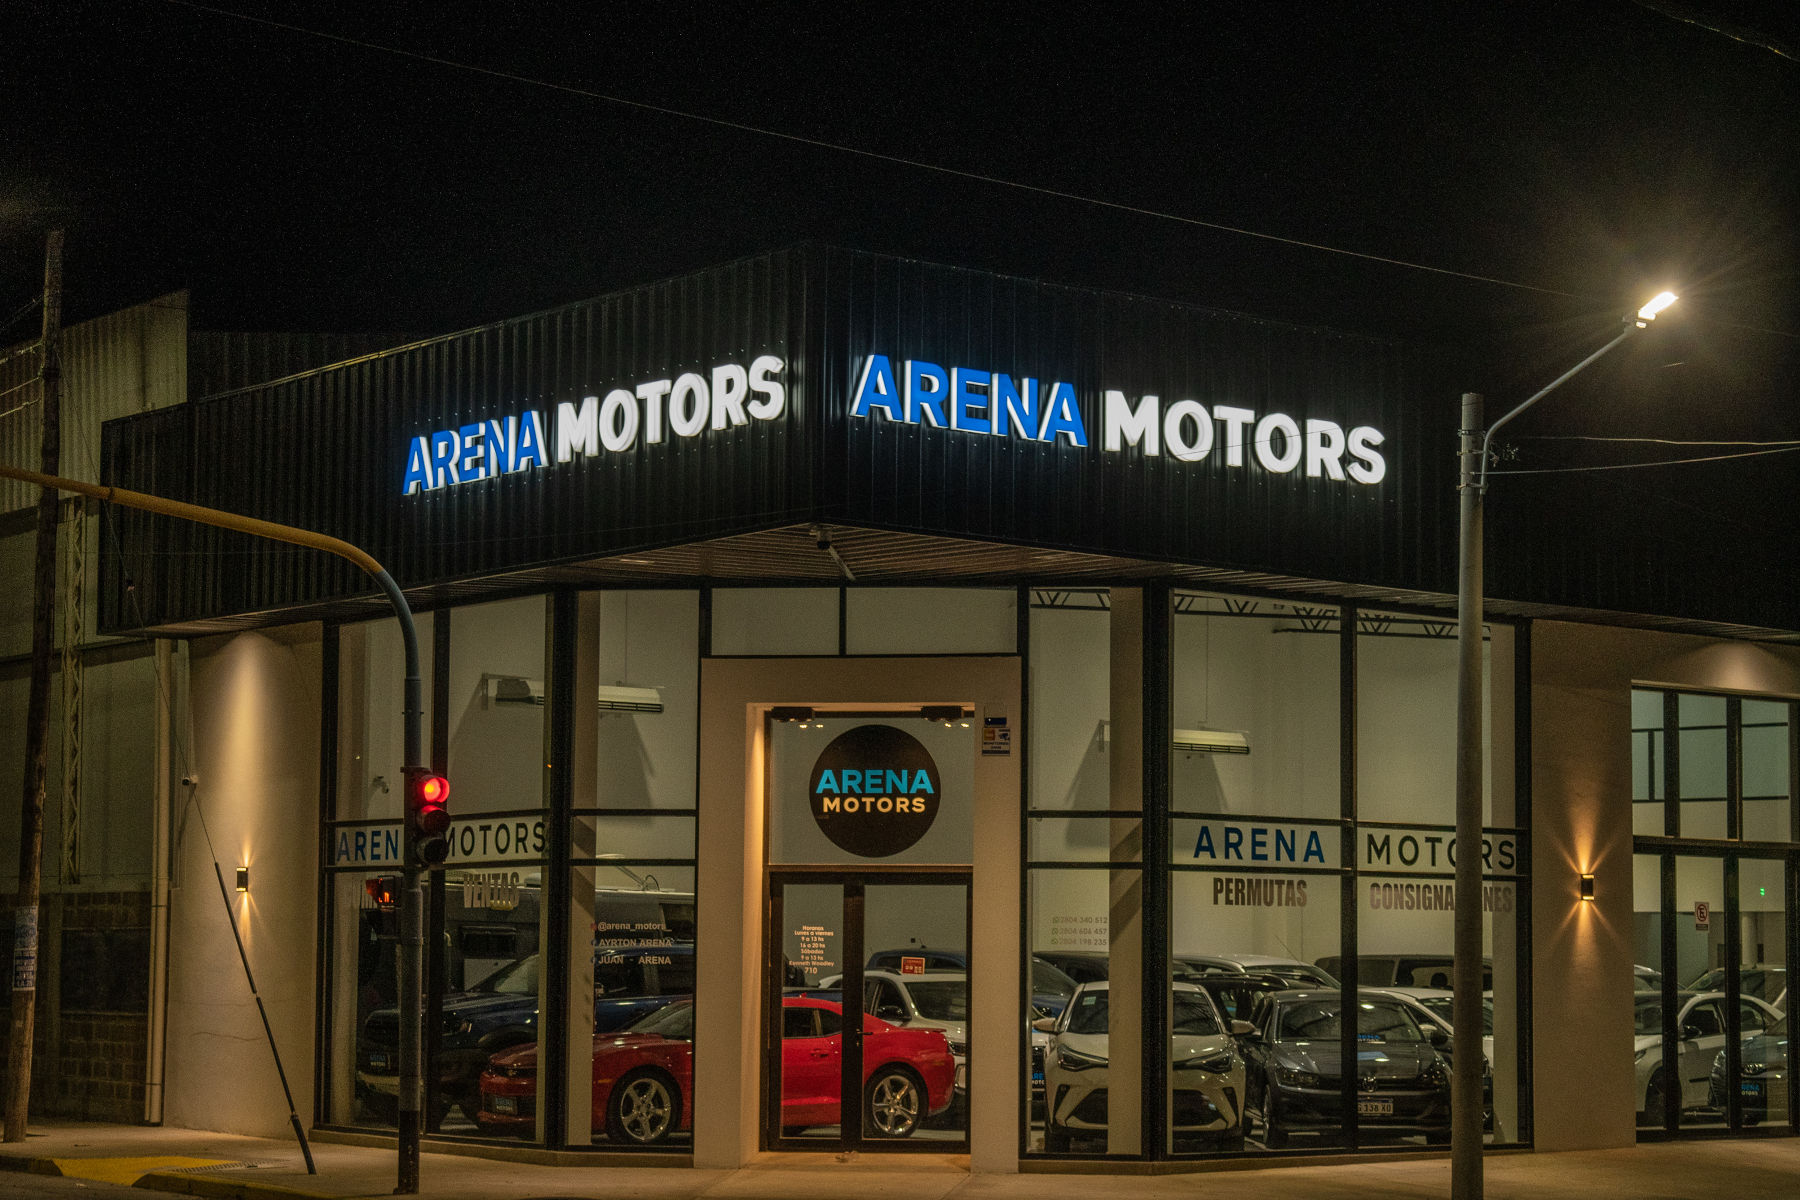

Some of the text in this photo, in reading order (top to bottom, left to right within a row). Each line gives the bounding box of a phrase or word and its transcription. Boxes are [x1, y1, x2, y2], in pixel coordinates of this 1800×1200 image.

[402, 355, 785, 496] ARENA MOTORS
[849, 354, 1386, 485] ARENA MOTORS
[816, 769, 934, 794] ARENA
[823, 797, 926, 813] MOTORS
[337, 829, 399, 862] AREN
[1193, 825, 1325, 863] ARENA
[463, 872, 520, 909] VENTAS
[1212, 877, 1308, 908] PERMUTAS
[1370, 883, 1513, 913] CONSIGNANES
[599, 938, 673, 948] AYRTON ARENA
[598, 955, 672, 965] JUAN ARENA
[804, 966, 818, 975] 710
